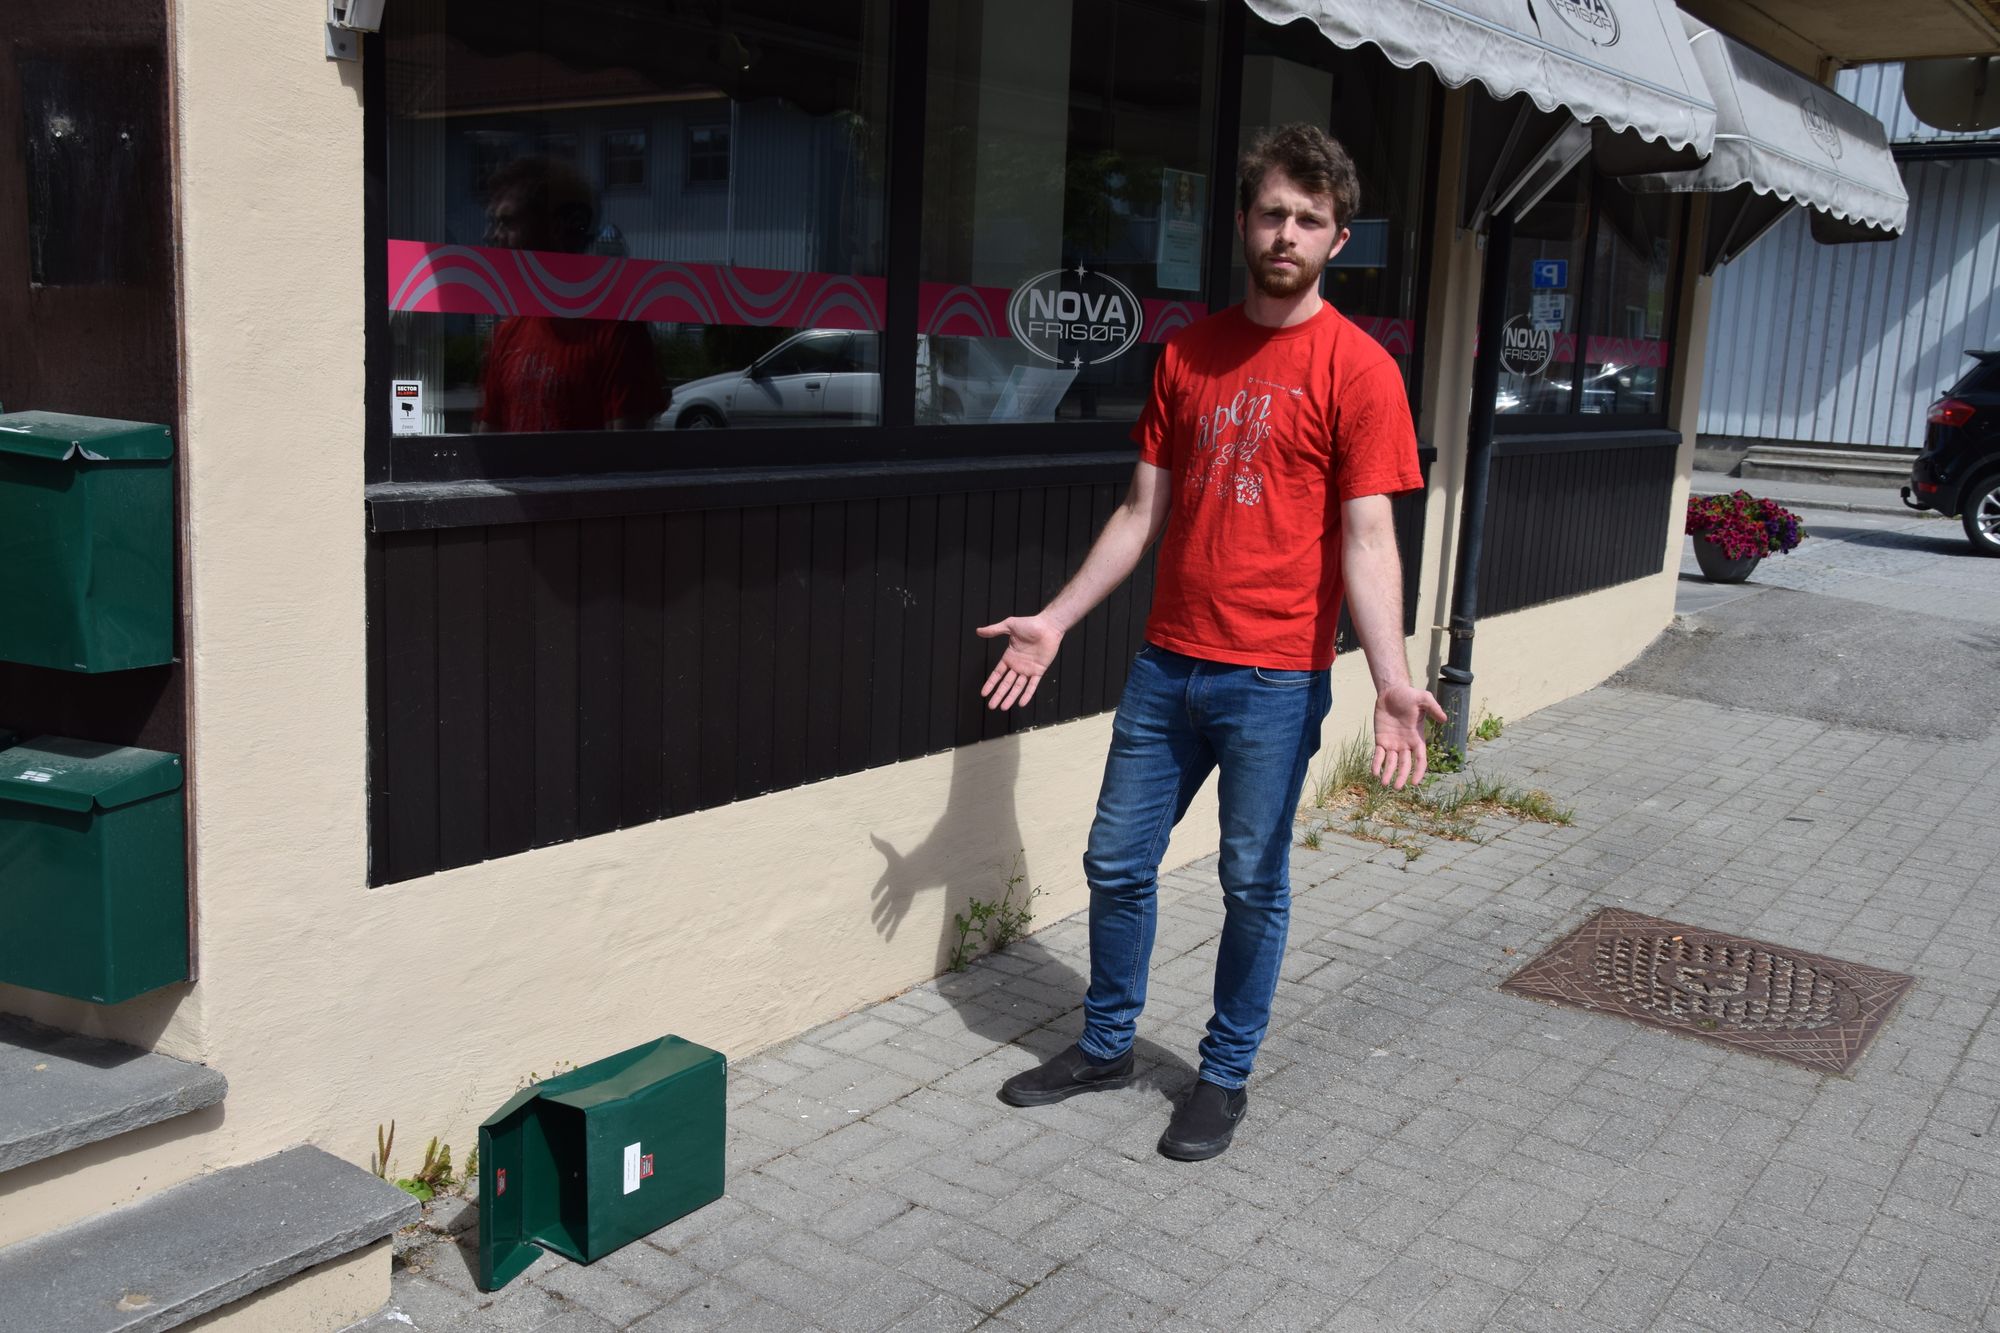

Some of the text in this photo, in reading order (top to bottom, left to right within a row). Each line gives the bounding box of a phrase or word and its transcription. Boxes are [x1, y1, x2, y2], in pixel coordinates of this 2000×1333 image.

[1555, 0, 1614, 33] FRISØR
[1028, 288, 1126, 323] NOVA
[1028, 321, 1128, 341] FRISØR
[1505, 327, 1547, 350] NOVA
[1504, 348, 1547, 362] FRISØR
[1198, 390, 1272, 453] åpen
[1246, 419, 1272, 446] lys
